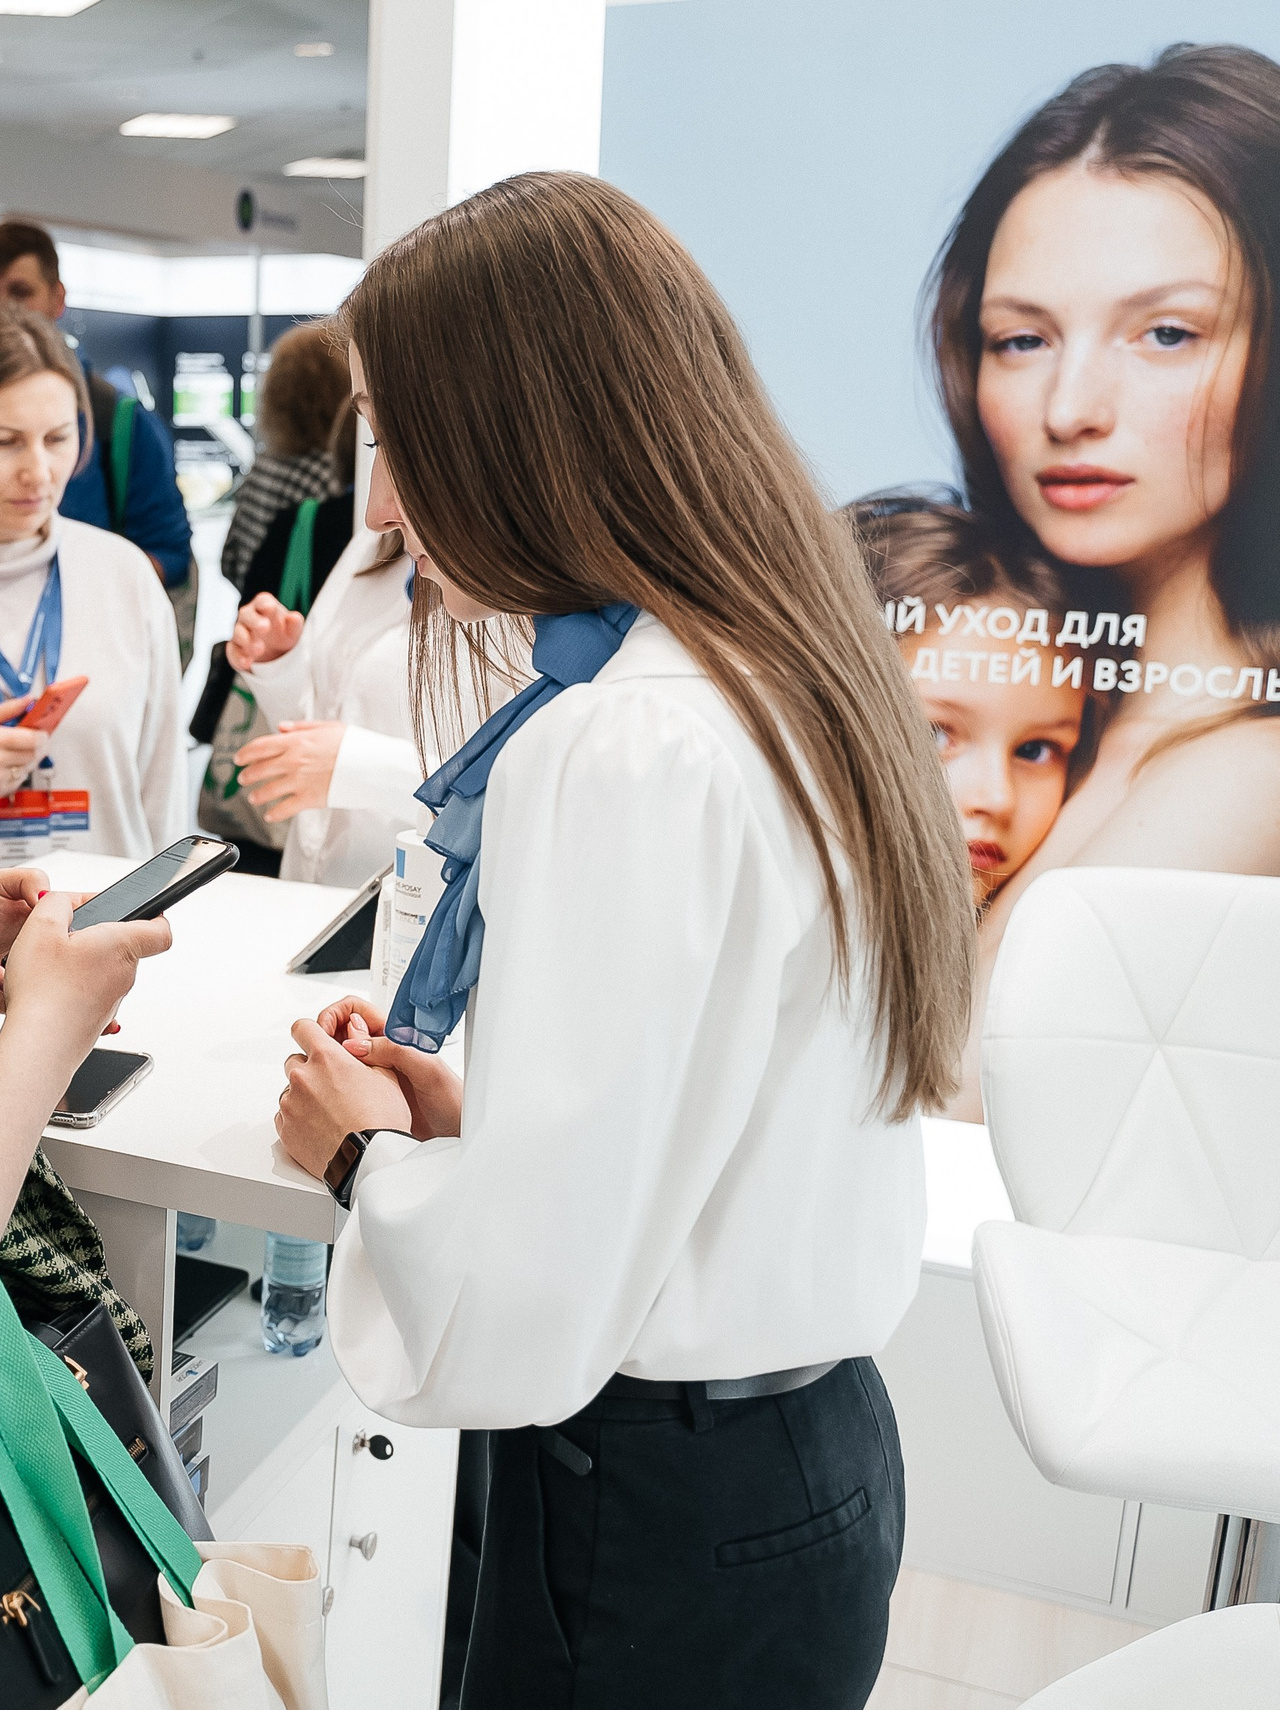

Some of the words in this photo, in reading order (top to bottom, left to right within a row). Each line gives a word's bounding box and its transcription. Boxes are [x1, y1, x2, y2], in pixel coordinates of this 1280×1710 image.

[885, 595, 927, 634] Й
[935, 603, 1051, 647] УХОД
[1055, 611, 1148, 649] ДЛЯ
[910, 647, 1042, 687] ДЕТЕЙ
[1052, 655, 1083, 690] И
